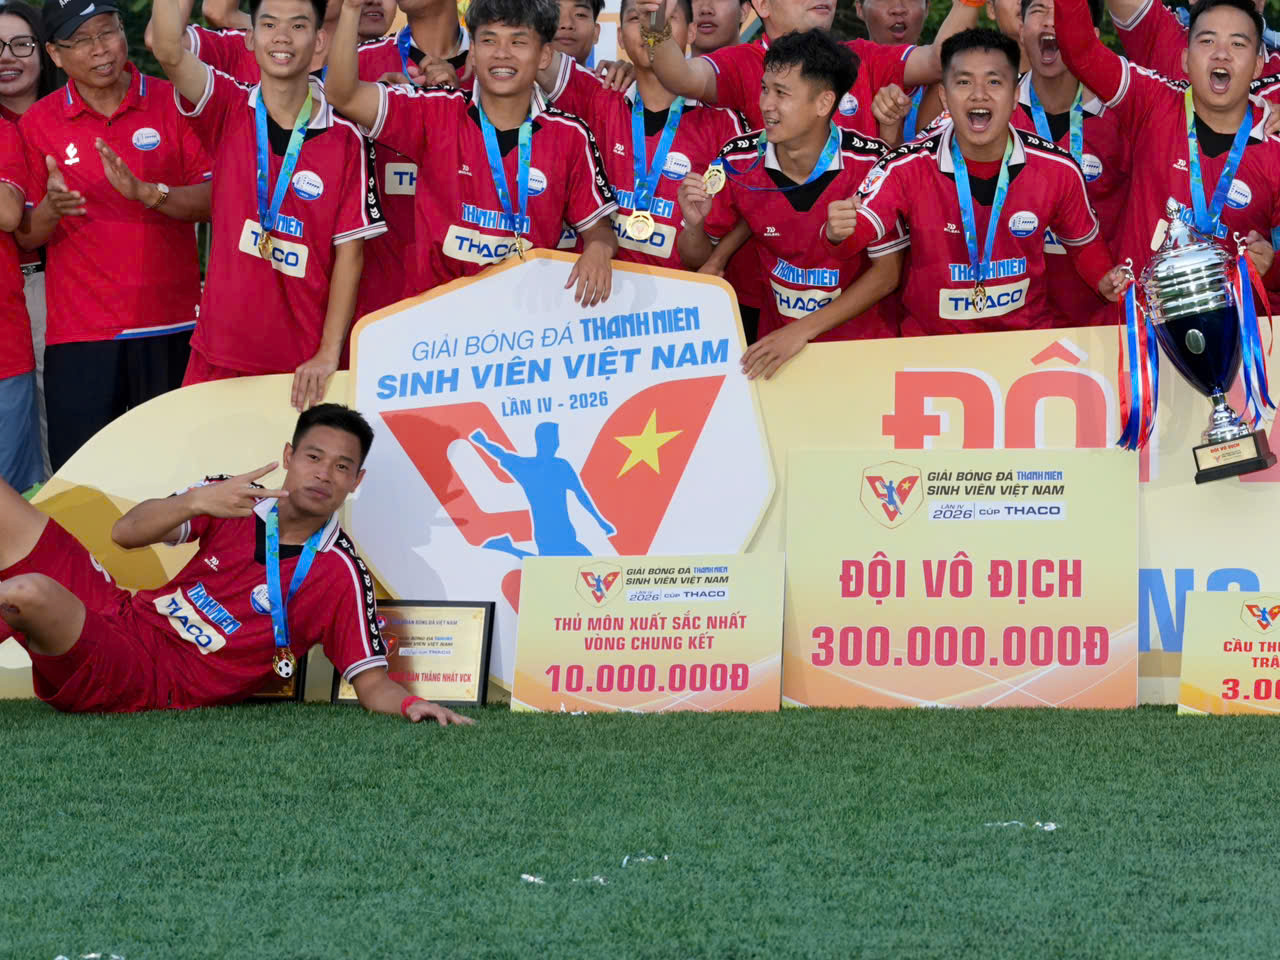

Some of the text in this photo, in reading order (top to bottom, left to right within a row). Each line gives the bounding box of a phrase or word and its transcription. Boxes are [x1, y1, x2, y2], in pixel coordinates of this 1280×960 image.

[412, 334, 458, 361] GIẢI
[464, 329, 534, 356] BÓNG
[541, 323, 574, 348] ĐÁ
[376, 338, 728, 400] SINH VIÊN VIỆT NAM
[502, 392, 608, 417] LẦN IV 2026
[956, 469, 992, 481] BÓNG
[996, 469, 1013, 481] ĐÁ
[927, 483, 1064, 497] SINH VIÊN VIỆT NAM
[933, 510, 972, 519] 2026
[1004, 506, 1060, 515] THACO
[839, 551, 1082, 605] ĐỘI VÔ ĐỊCH
[554, 610, 747, 631] THỦ MÔN XUẤT SẮC NHẤT
[584, 633, 715, 651] VÒNG CHUNG KẾT
[812, 626, 1110, 667] 300.000.000Đ
[1223, 638, 1253, 653] CẦU
[545, 663, 749, 692] 10.000.000Đ
